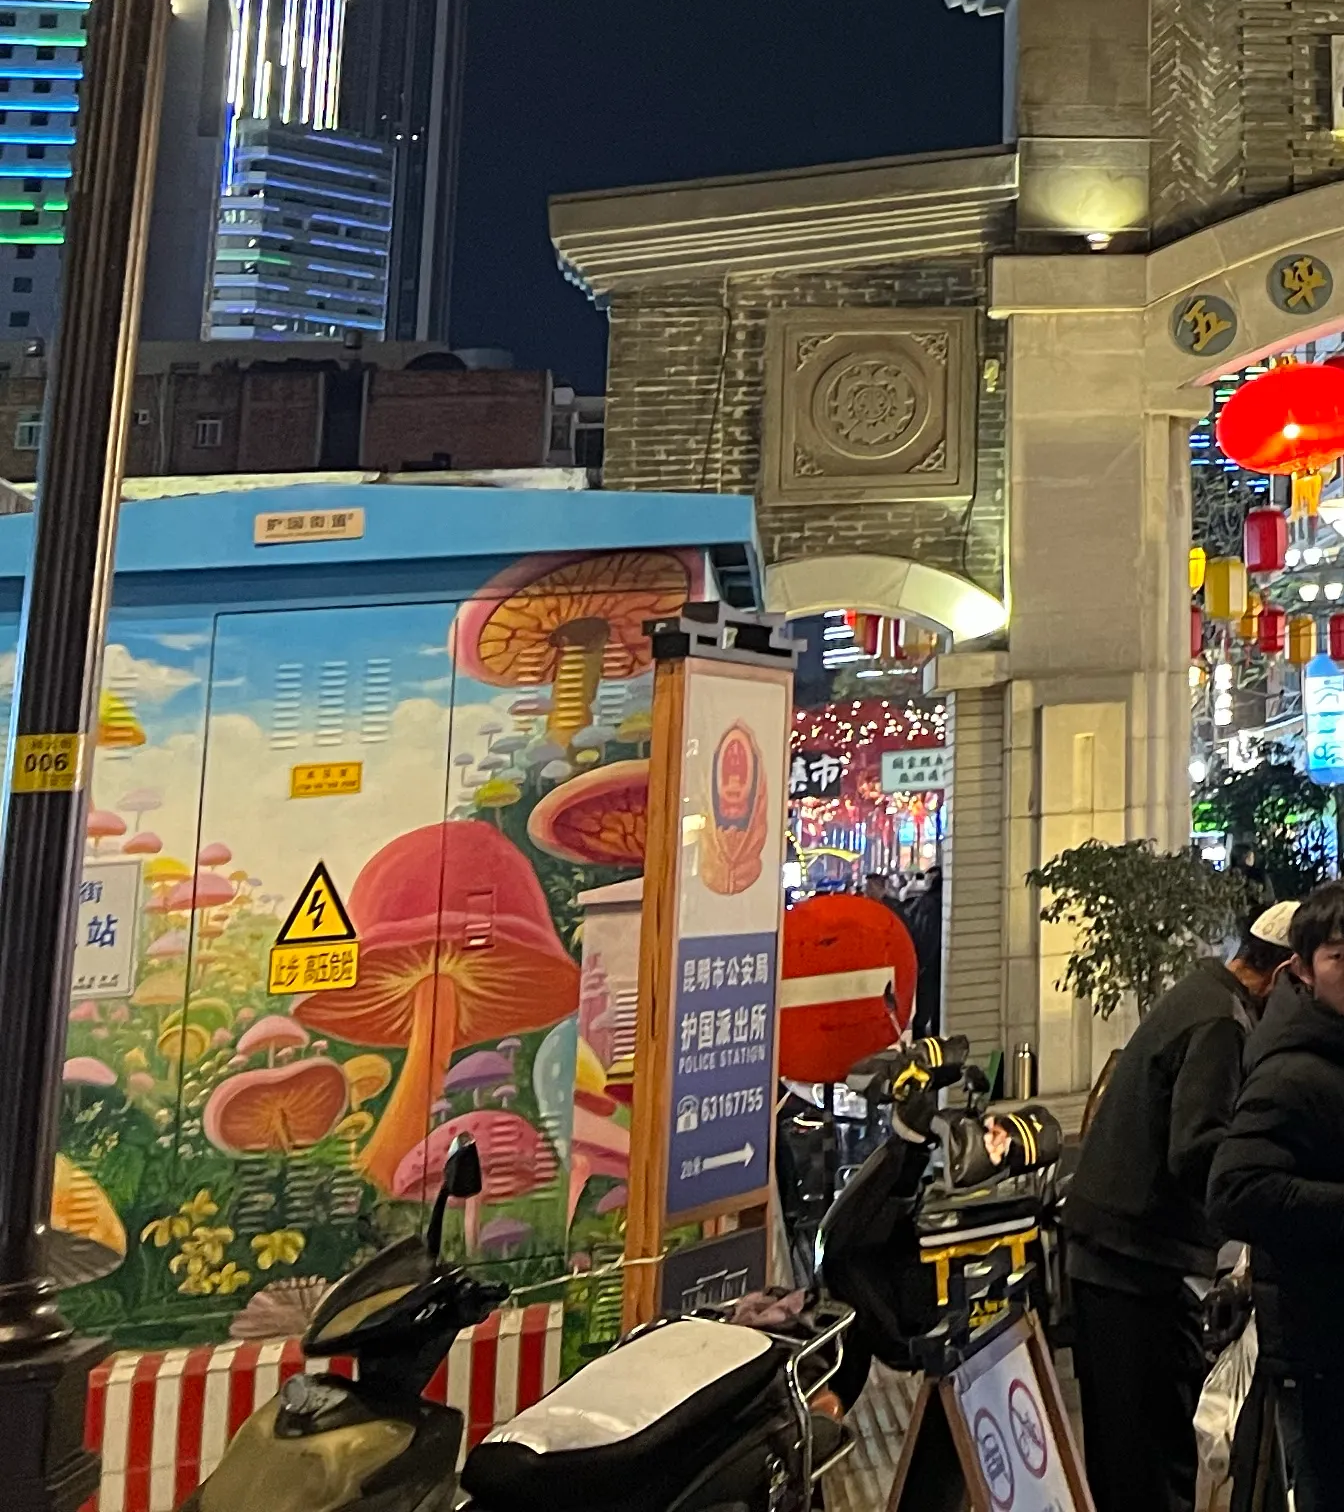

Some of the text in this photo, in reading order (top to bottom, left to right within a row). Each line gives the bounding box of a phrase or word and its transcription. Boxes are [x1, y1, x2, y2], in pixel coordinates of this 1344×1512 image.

[24, 753, 69, 773] 006
[682, 953, 769, 993] 昆明市公安局
[680, 1004, 768, 1053] 护国派出所
[678, 1044, 766, 1075] POLICE STATION
